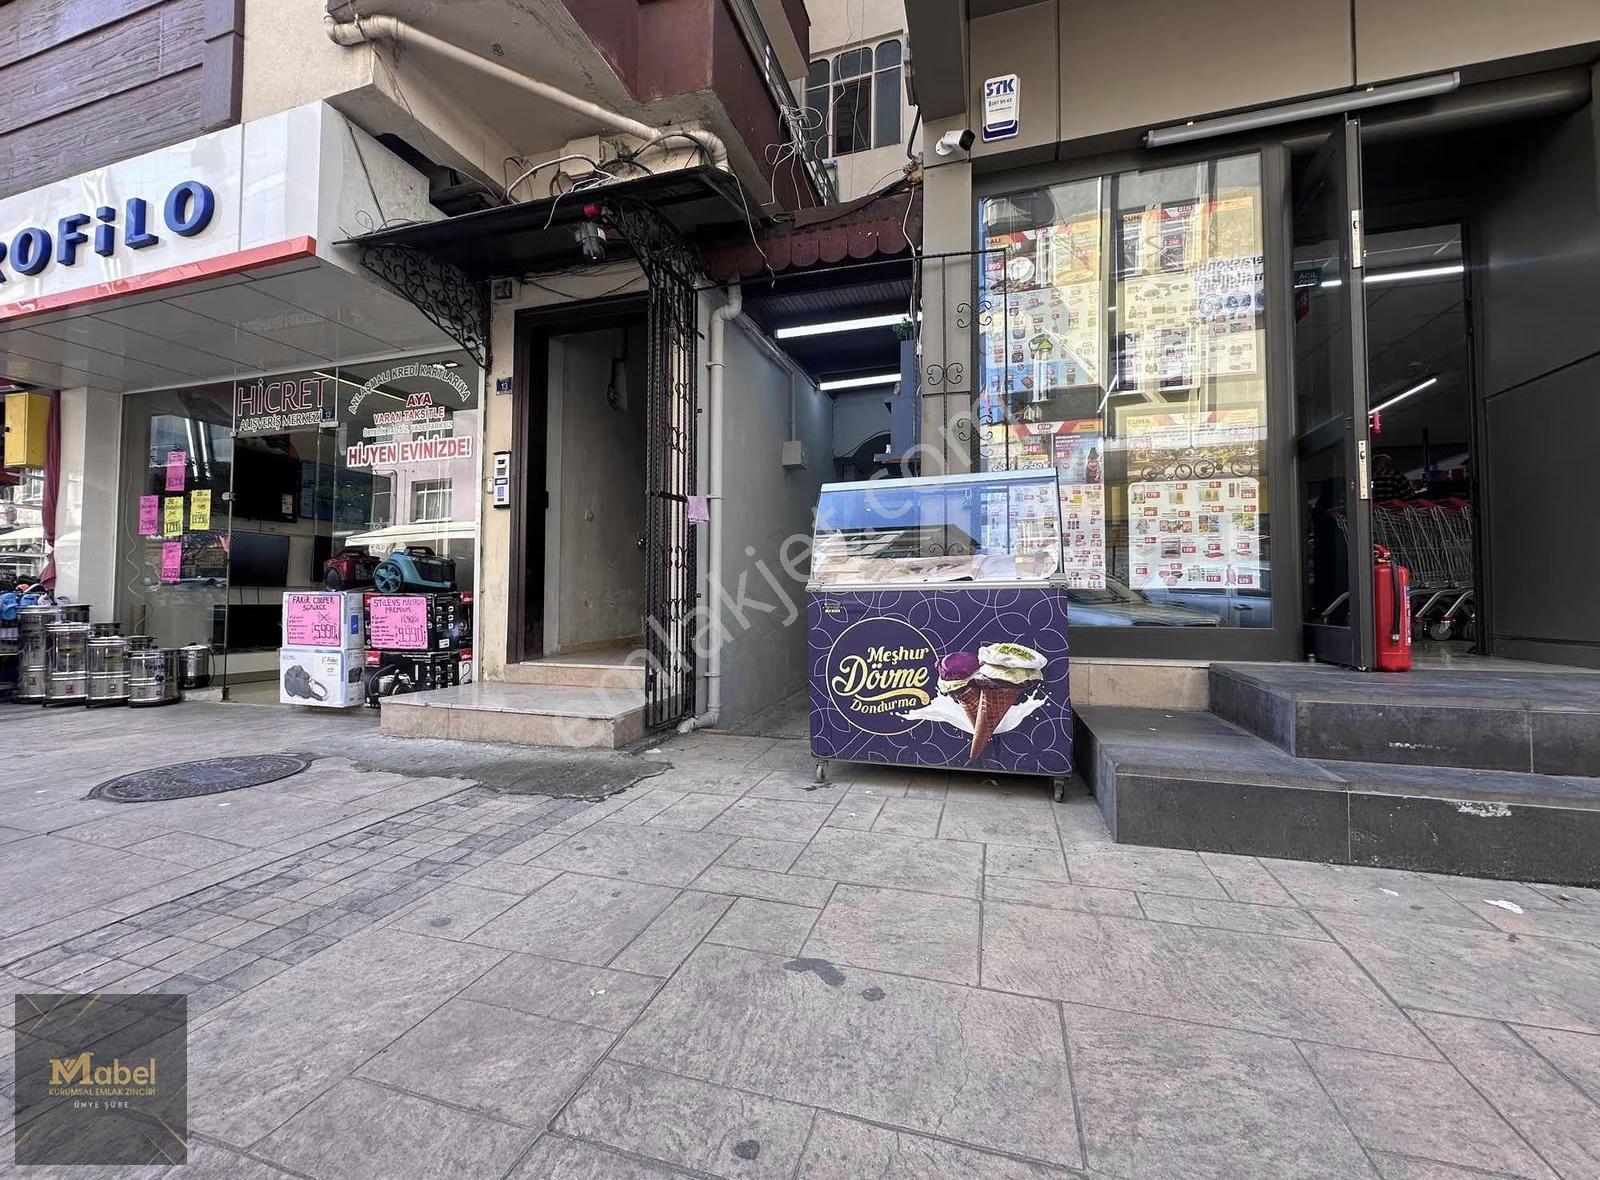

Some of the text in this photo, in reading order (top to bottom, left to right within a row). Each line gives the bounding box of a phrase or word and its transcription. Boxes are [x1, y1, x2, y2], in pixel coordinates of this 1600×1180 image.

[348, 363, 471, 415] ANLAŞMALI KREDİ KARTLARINA
[406, 392, 432, 407] AYA
[240, 409, 323, 432] ALIŞVERİŞ MERKEZİ
[373, 406, 445, 425] VARAN TAKSİTLE
[347, 436, 472, 467] HİJYEN EVİNİZDE!
[867, 646, 929, 665] Meşhur
[831, 655, 930, 696] Dövme
[850, 697, 917, 714] Dondurma
